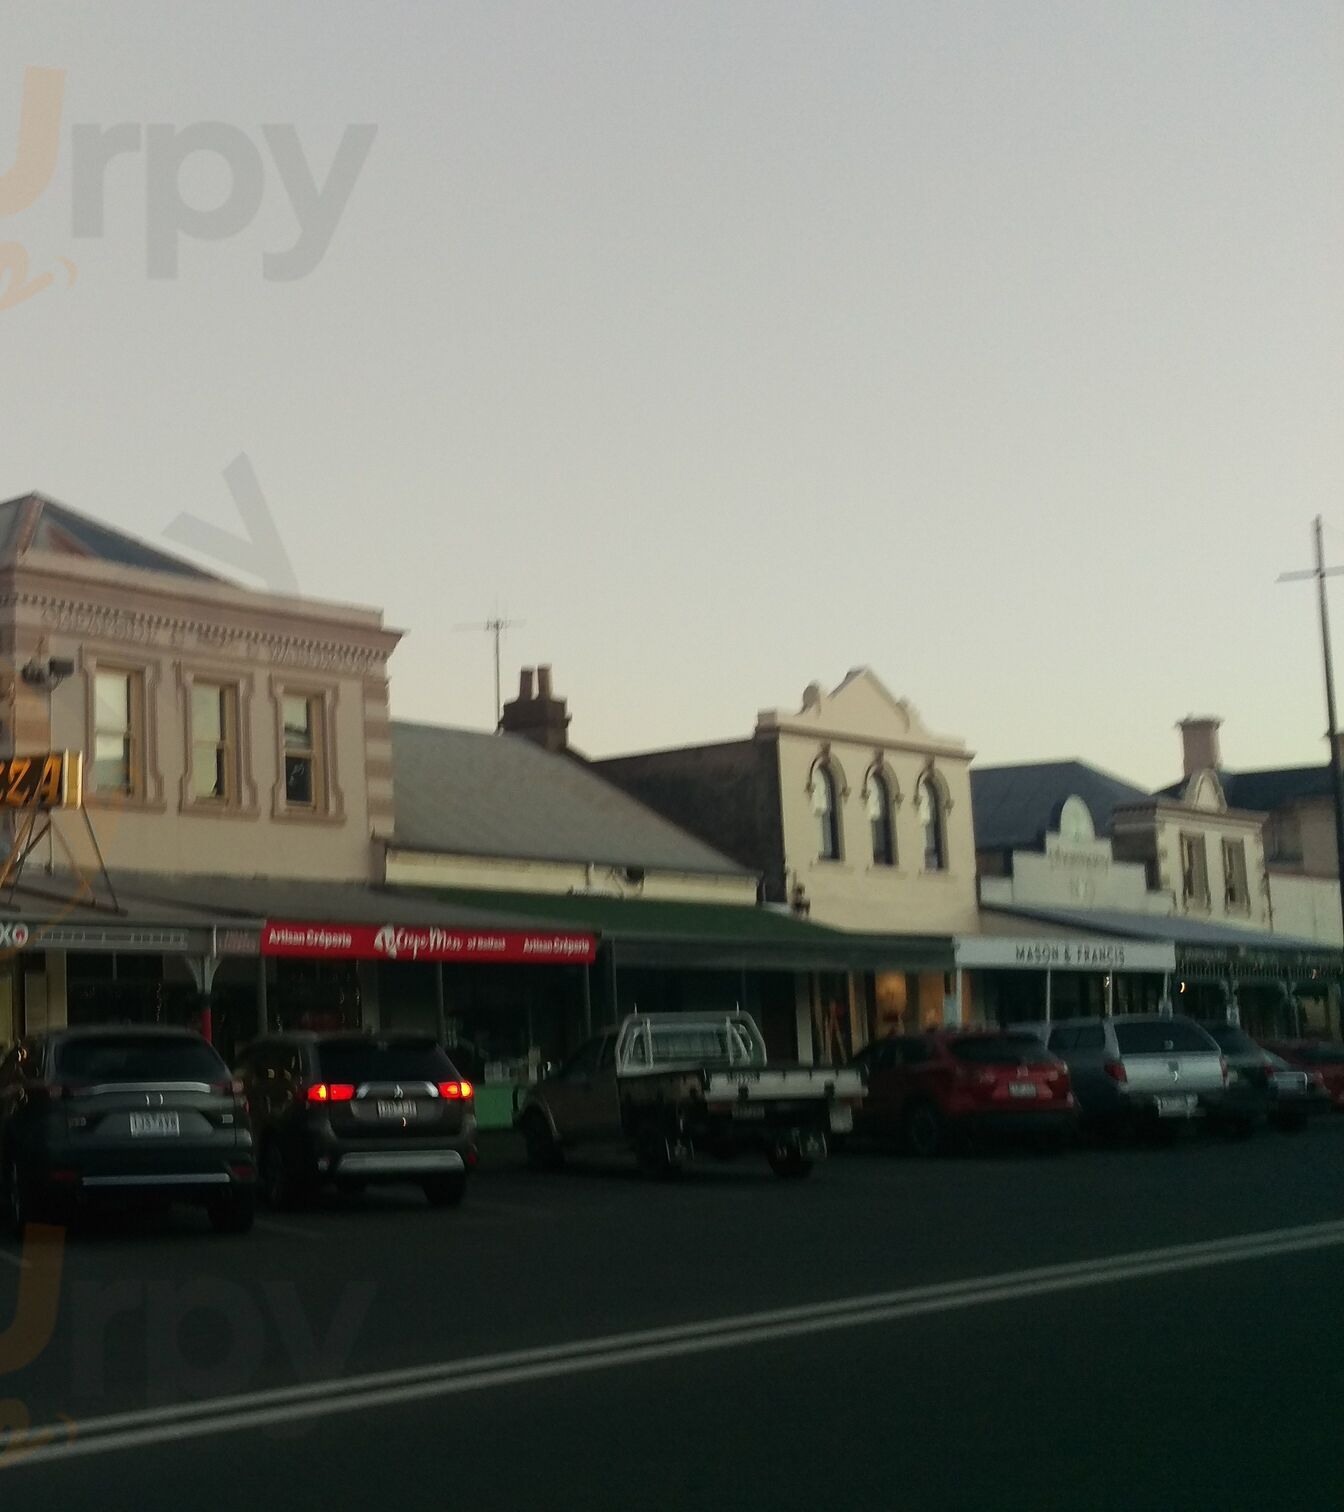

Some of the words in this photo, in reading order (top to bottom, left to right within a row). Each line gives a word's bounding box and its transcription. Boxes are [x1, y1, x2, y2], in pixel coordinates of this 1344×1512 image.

[268, 928, 305, 945] Artisan
[1016, 944, 1059, 961] MASON
[1078, 946, 1126, 964] FRANCIS
